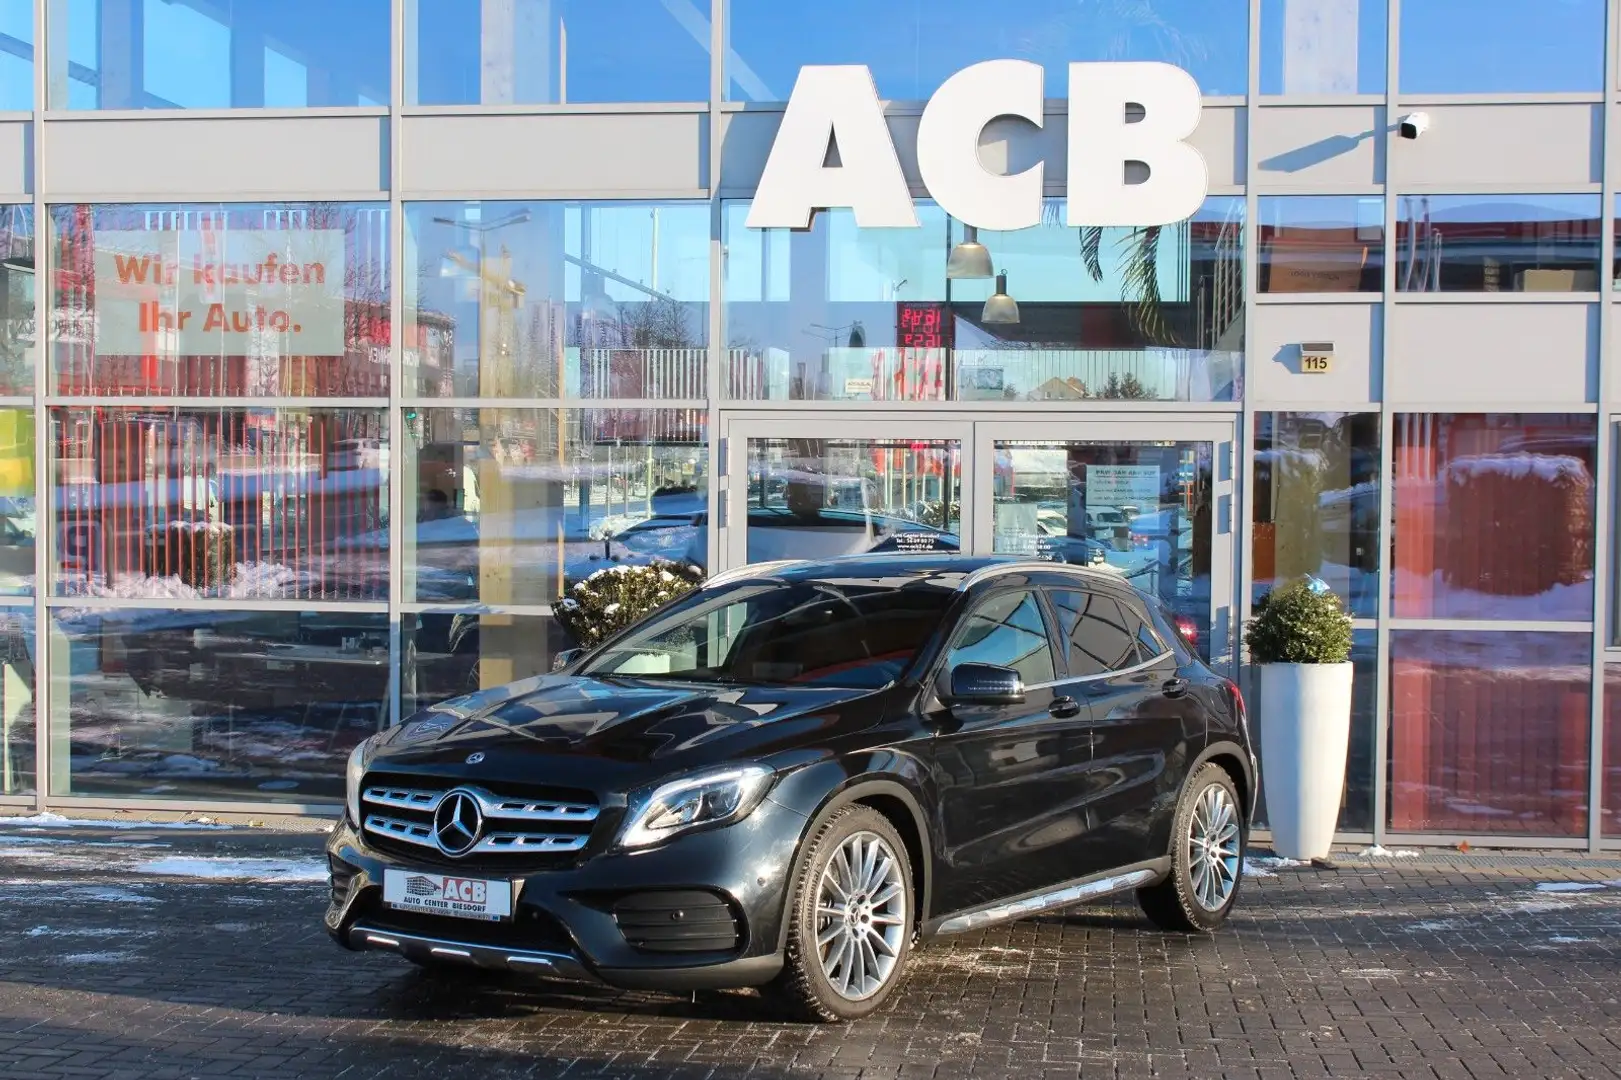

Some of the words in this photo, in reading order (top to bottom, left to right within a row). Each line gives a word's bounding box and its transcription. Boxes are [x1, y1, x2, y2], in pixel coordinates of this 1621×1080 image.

[745, 58, 1209, 231] ACB
[114, 253, 178, 285] Wir
[193, 252, 325, 284] kaufen
[139, 301, 192, 332] Ihr
[203, 303, 302, 332] Auto.
[1305, 357, 1327, 369] 115
[404, 896, 421, 905] AUTO
[424, 899, 448, 909] CENTER
[452, 901, 486, 912] BIESDORF
[443, 879, 487, 903] ACB
